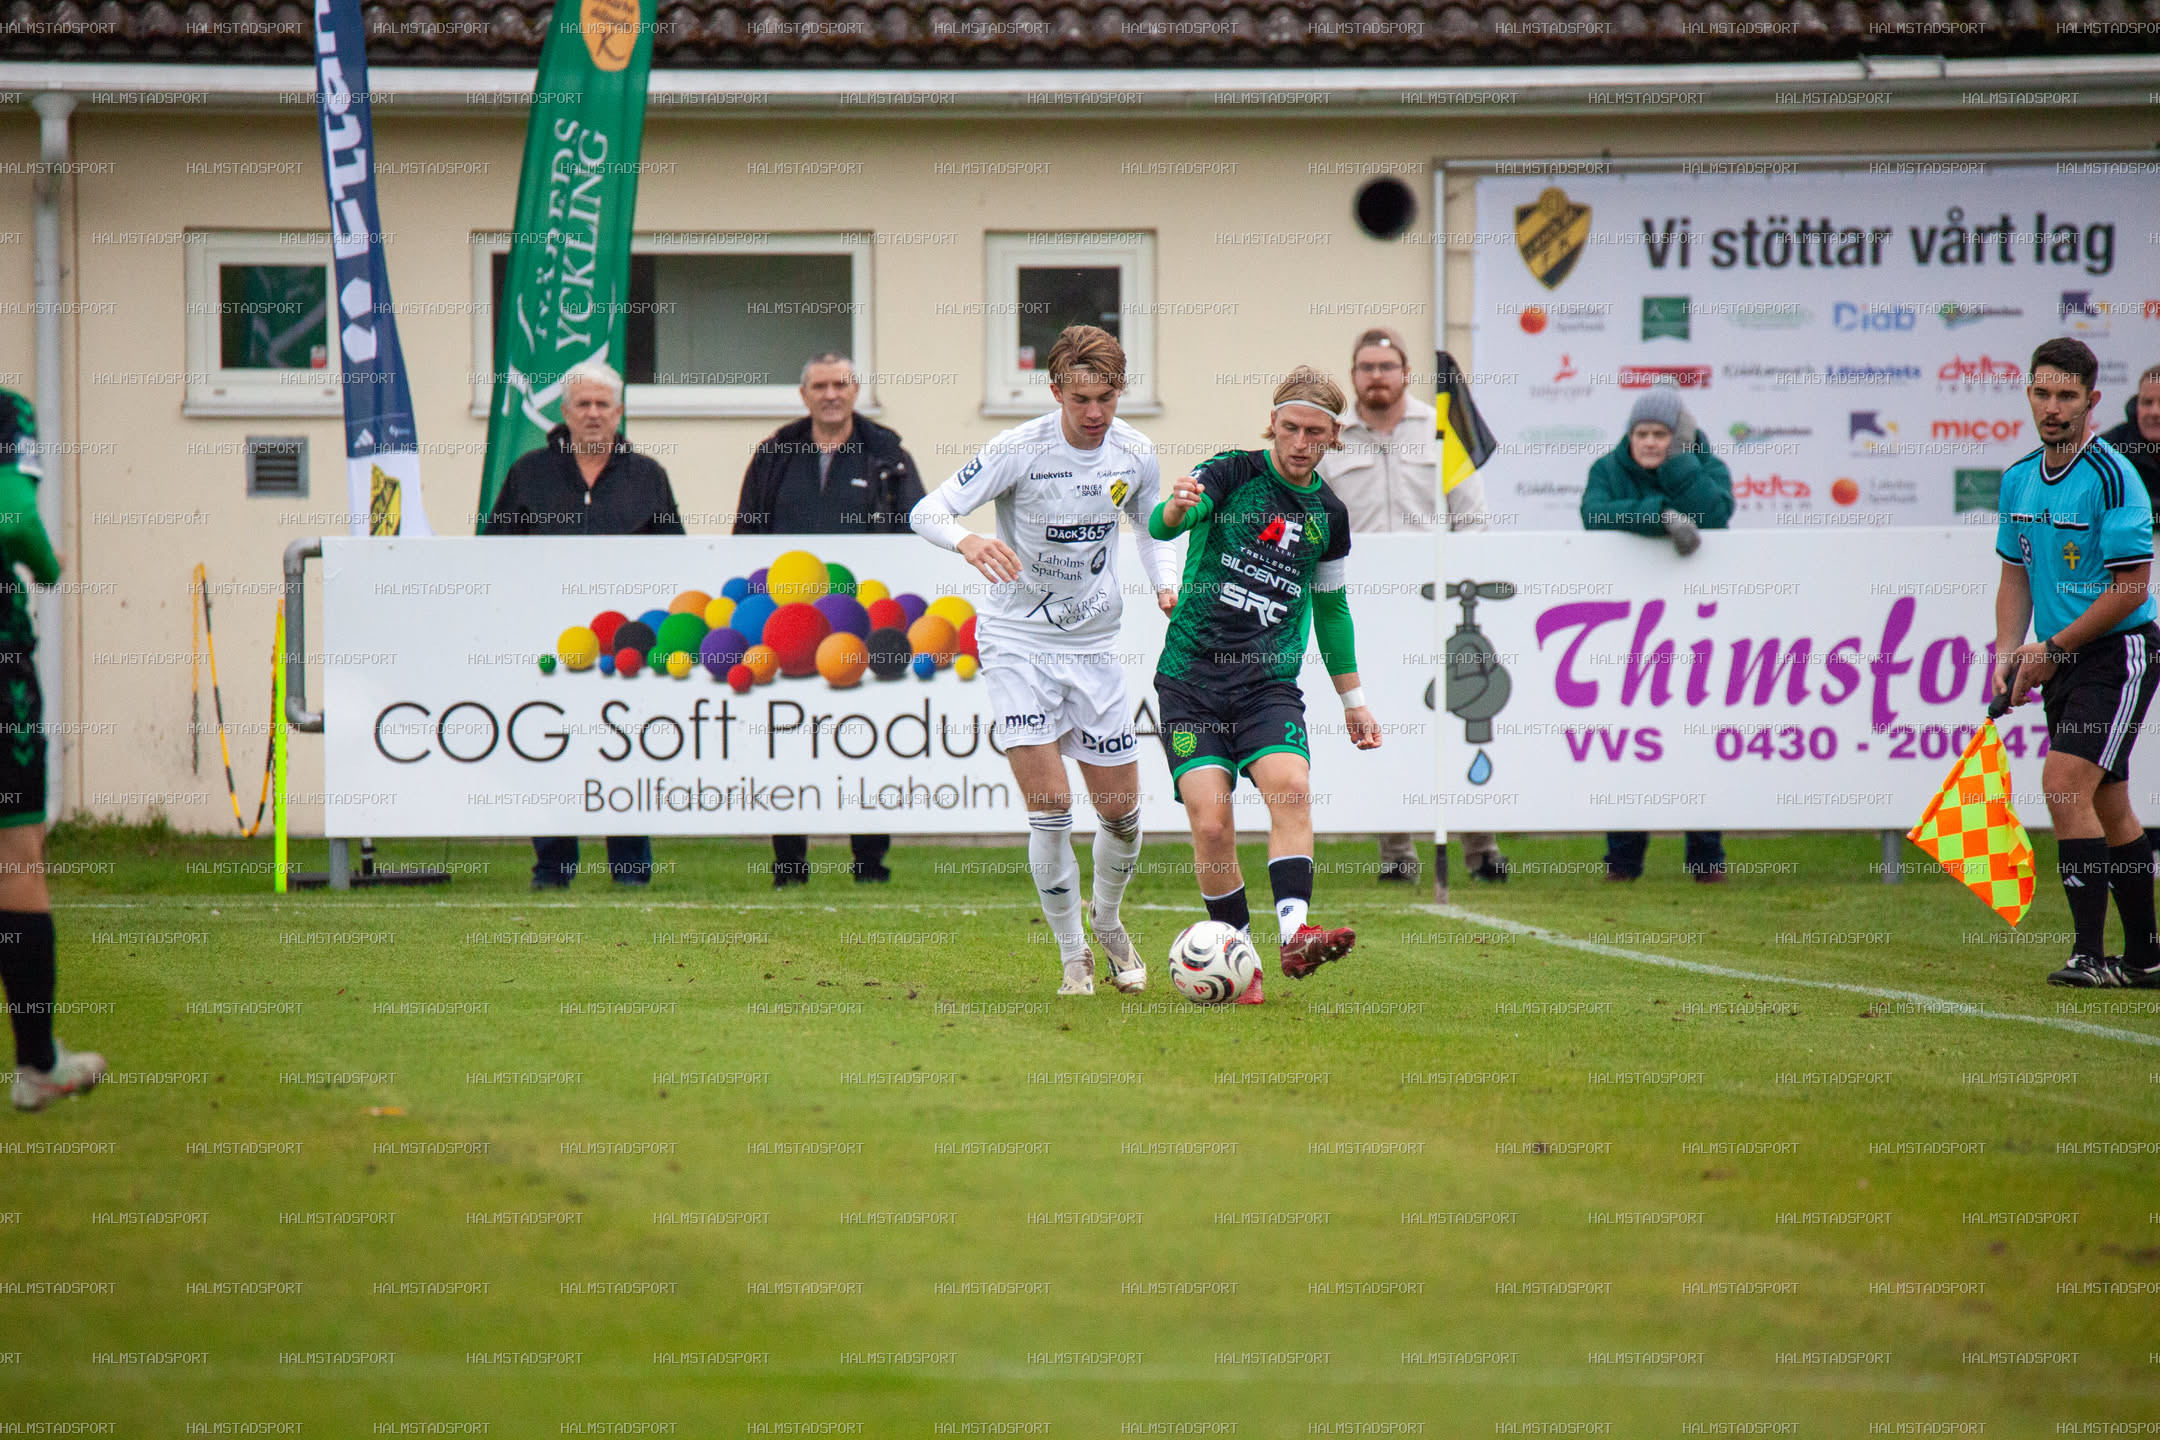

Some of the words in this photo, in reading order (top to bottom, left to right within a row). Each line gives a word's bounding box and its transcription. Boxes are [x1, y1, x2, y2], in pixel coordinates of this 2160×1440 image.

[1642, 217, 1691, 269] Vi
[1711, 215, 1893, 269] stöttar
[1909, 206, 2017, 268] vårt
[2034, 211, 2115, 276] lag
[1833, 301, 1916, 331] Diab
[1932, 420, 2024, 441] micor
[1032, 563, 1083, 581] Sparbank
[1038, 552, 1085, 568] Laholms
[1220, 552, 1302, 598] BILCENTER
[1219, 582, 1288, 627] SRC
[1535, 597, 2043, 727] Thimsfo
[373, 701, 570, 764] COG
[598, 697, 736, 763] Soft
[1284, 721, 1307, 751] 22
[1564, 727, 1664, 762] VVS
[1715, 727, 1838, 762] 0430
[584, 777, 821, 812] Bollfabriken
[837, 775, 843, 810] i
[861, 776, 1009, 810] Laholm
